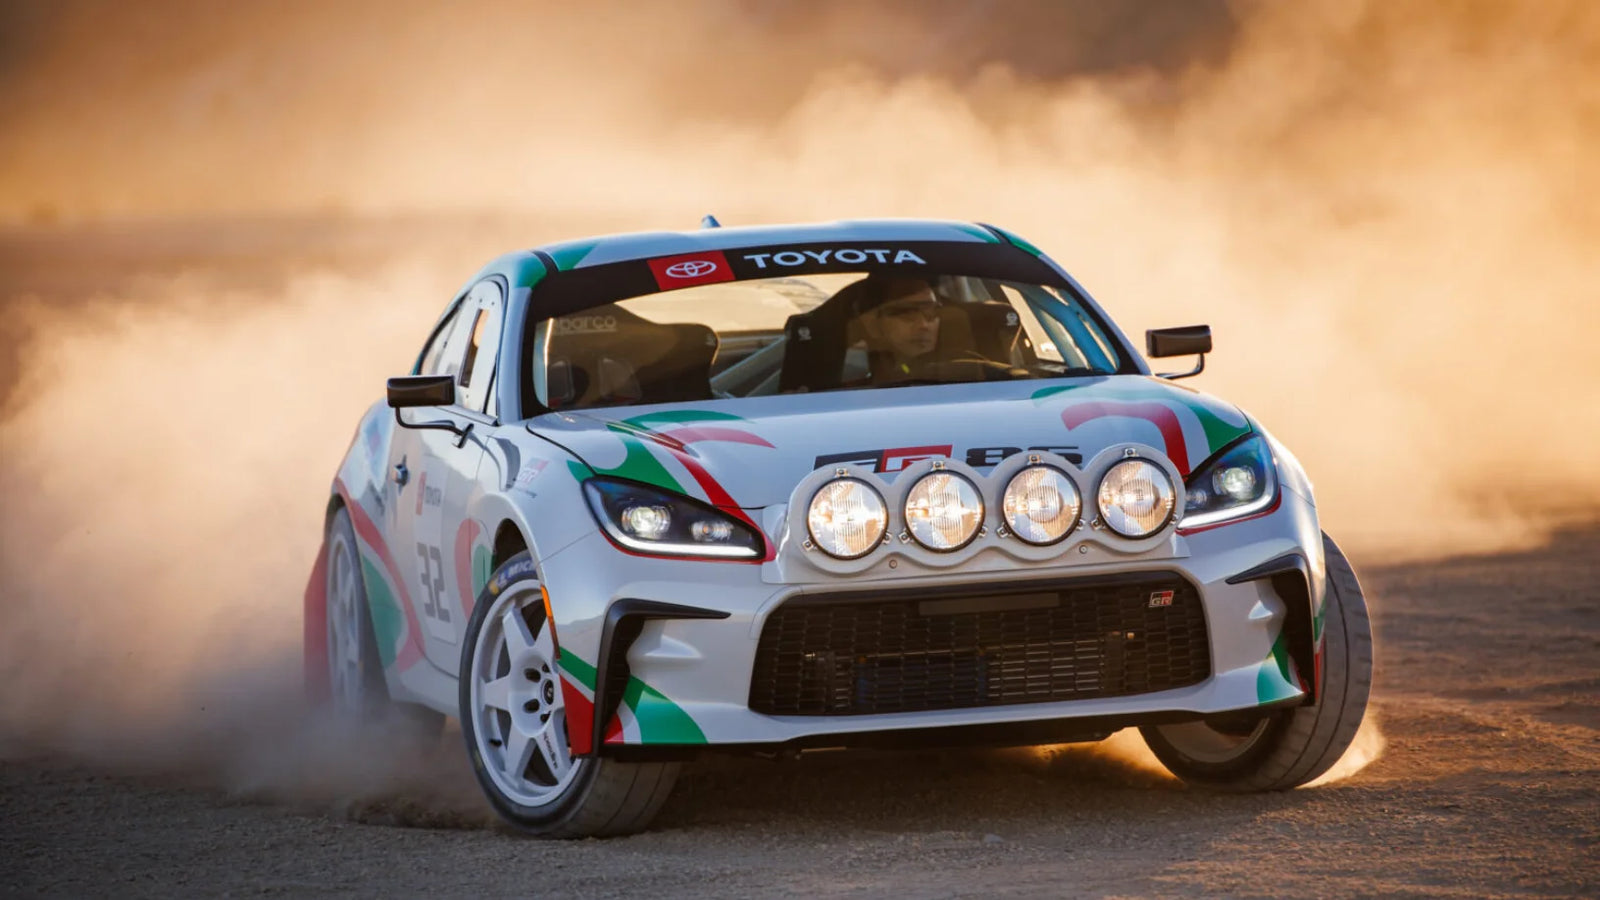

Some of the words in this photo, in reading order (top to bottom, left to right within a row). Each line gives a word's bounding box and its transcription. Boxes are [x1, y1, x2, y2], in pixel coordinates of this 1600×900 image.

[743, 249, 927, 269] TOYOTA
[553, 315, 617, 336] parco
[417, 542, 450, 623] 32
[1150, 595, 1173, 606] GR
